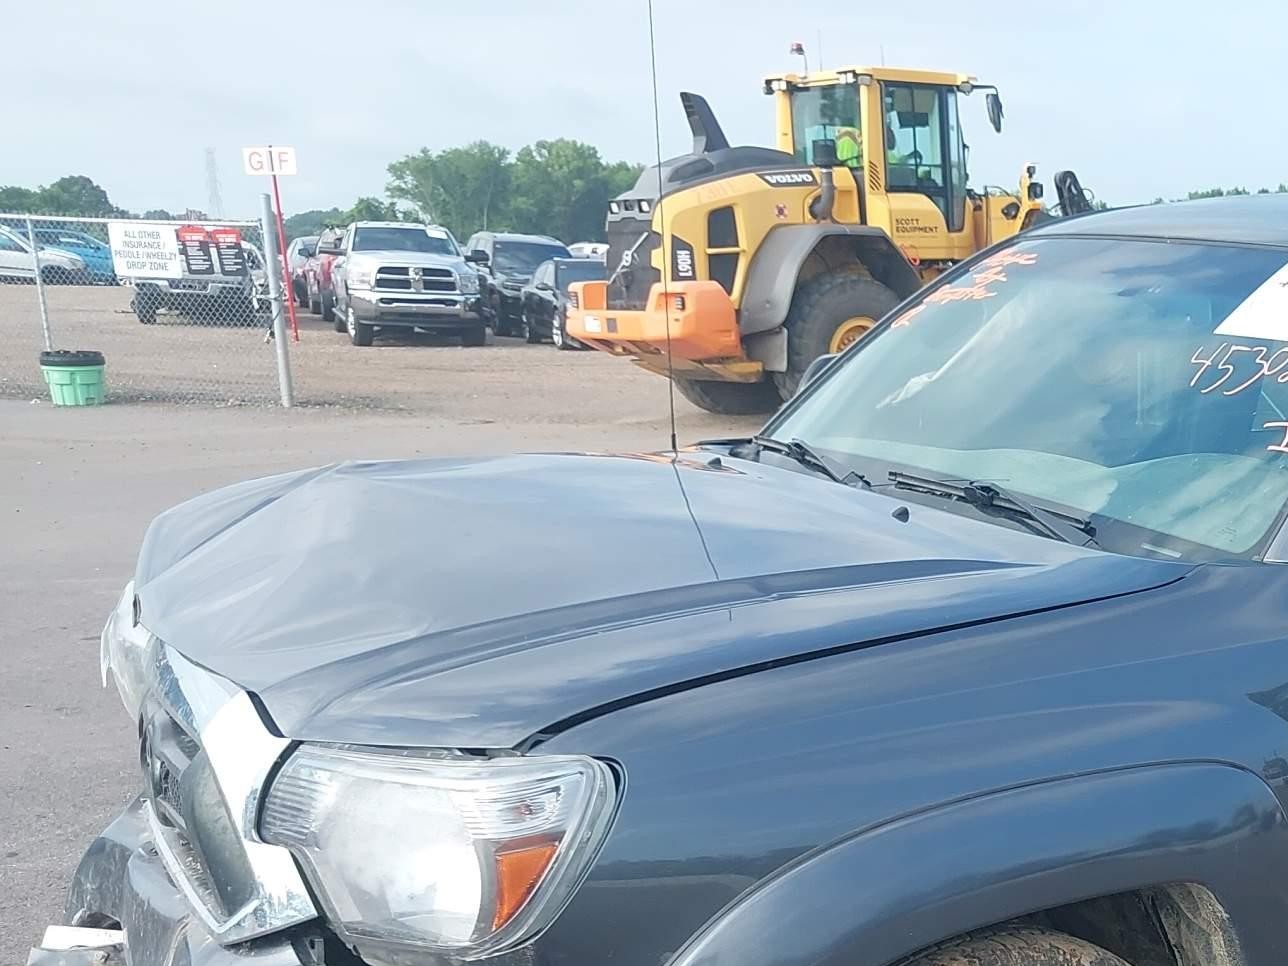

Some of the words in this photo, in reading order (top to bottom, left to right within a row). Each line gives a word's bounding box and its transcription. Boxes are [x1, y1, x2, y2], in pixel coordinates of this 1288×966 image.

[764, 173, 813, 184] VOLVO
[895, 217, 920, 226] SCOTT
[123, 229, 137, 239] ALL
[137, 230, 161, 240] OTHER
[895, 225, 939, 234] EQUIPMENT
[121, 240, 162, 250] INSURANCE
[126, 260, 147, 270] DROP
[148, 261, 169, 271] ZONE
[676, 249, 693, 277] L90H
